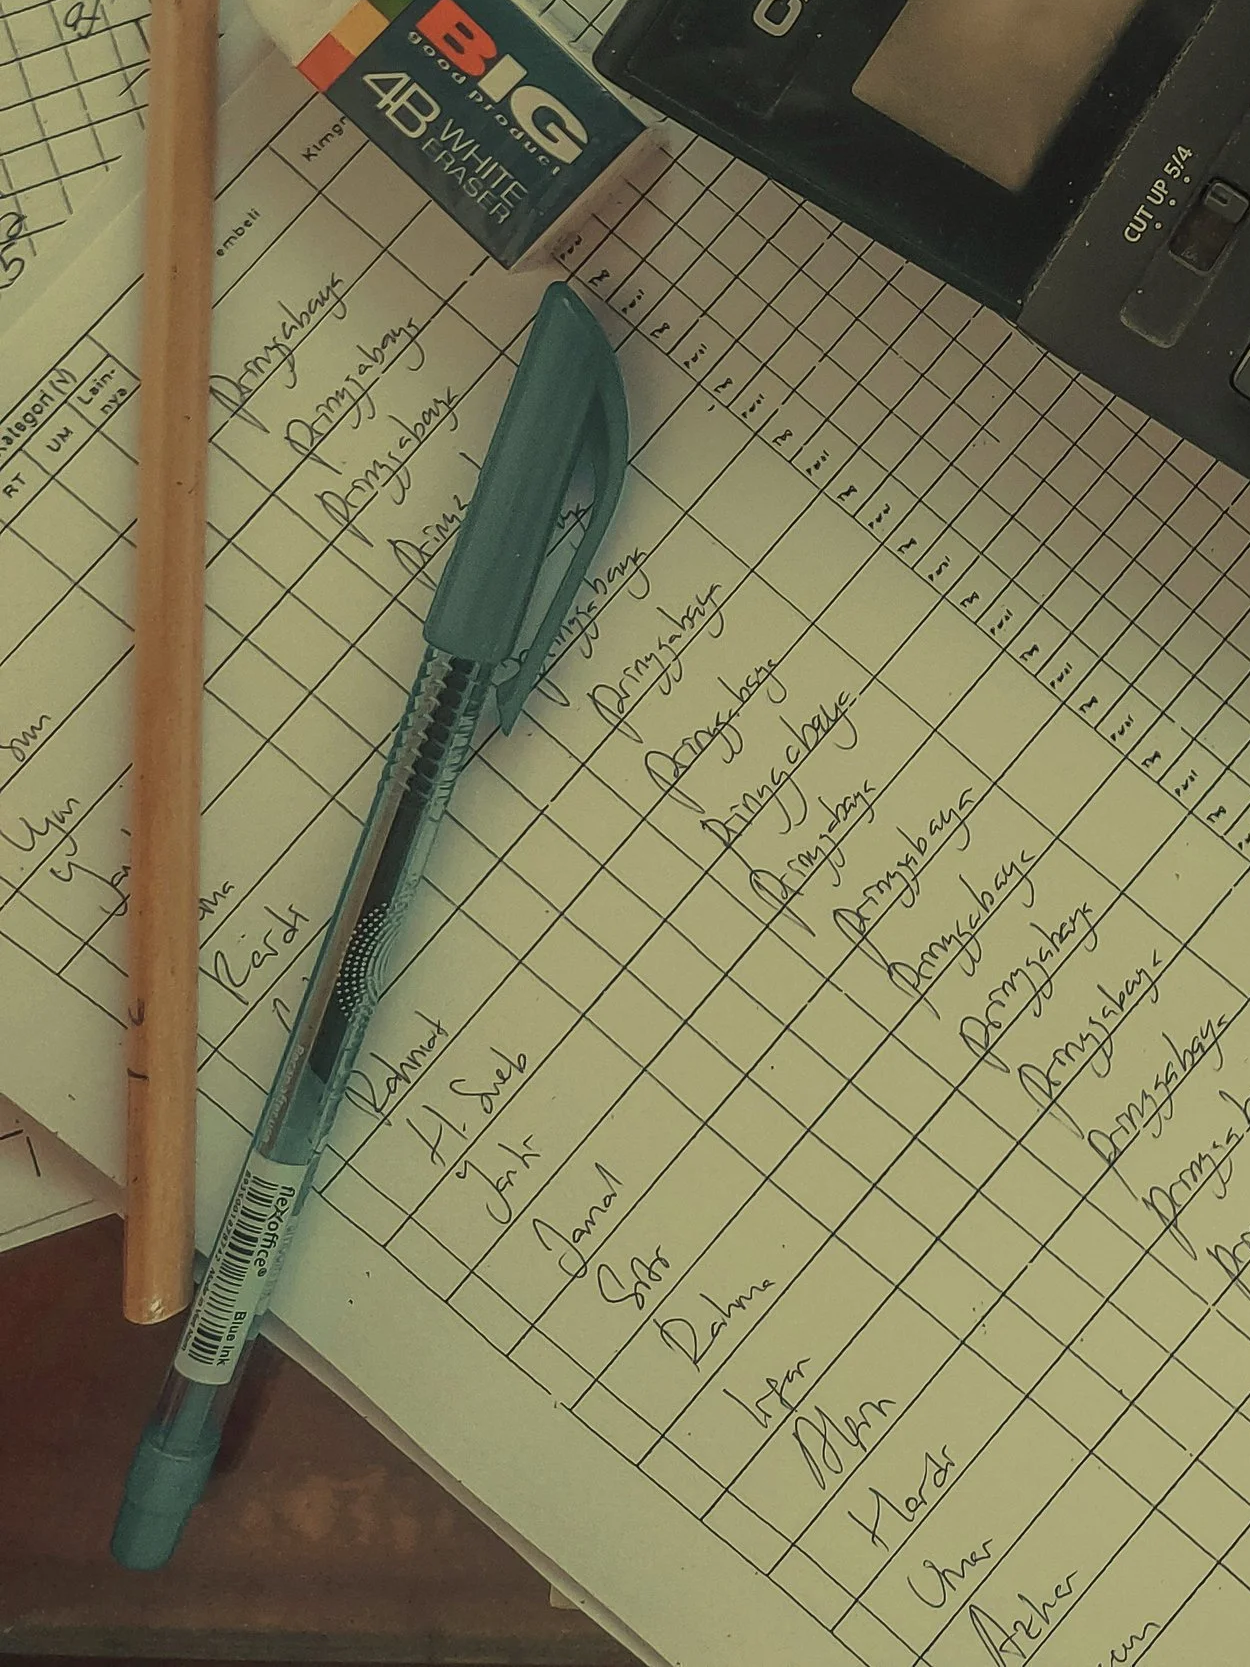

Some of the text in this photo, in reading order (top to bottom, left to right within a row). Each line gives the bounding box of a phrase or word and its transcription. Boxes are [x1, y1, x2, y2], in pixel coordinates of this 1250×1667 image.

[362, 71, 443, 138] 4B
[407, 31, 561, 176] good product
[422, 136, 510, 224] ERASER
[438, 118, 528, 204] WHITE
[1123, 144, 1194, 244] CUT UP 5/4
[215, 208, 261, 259] embeli
[45, 426, 74, 452] UM
[2, 472, 26, 499] RT
[216, 1310, 248, 1366] Blue Ink
